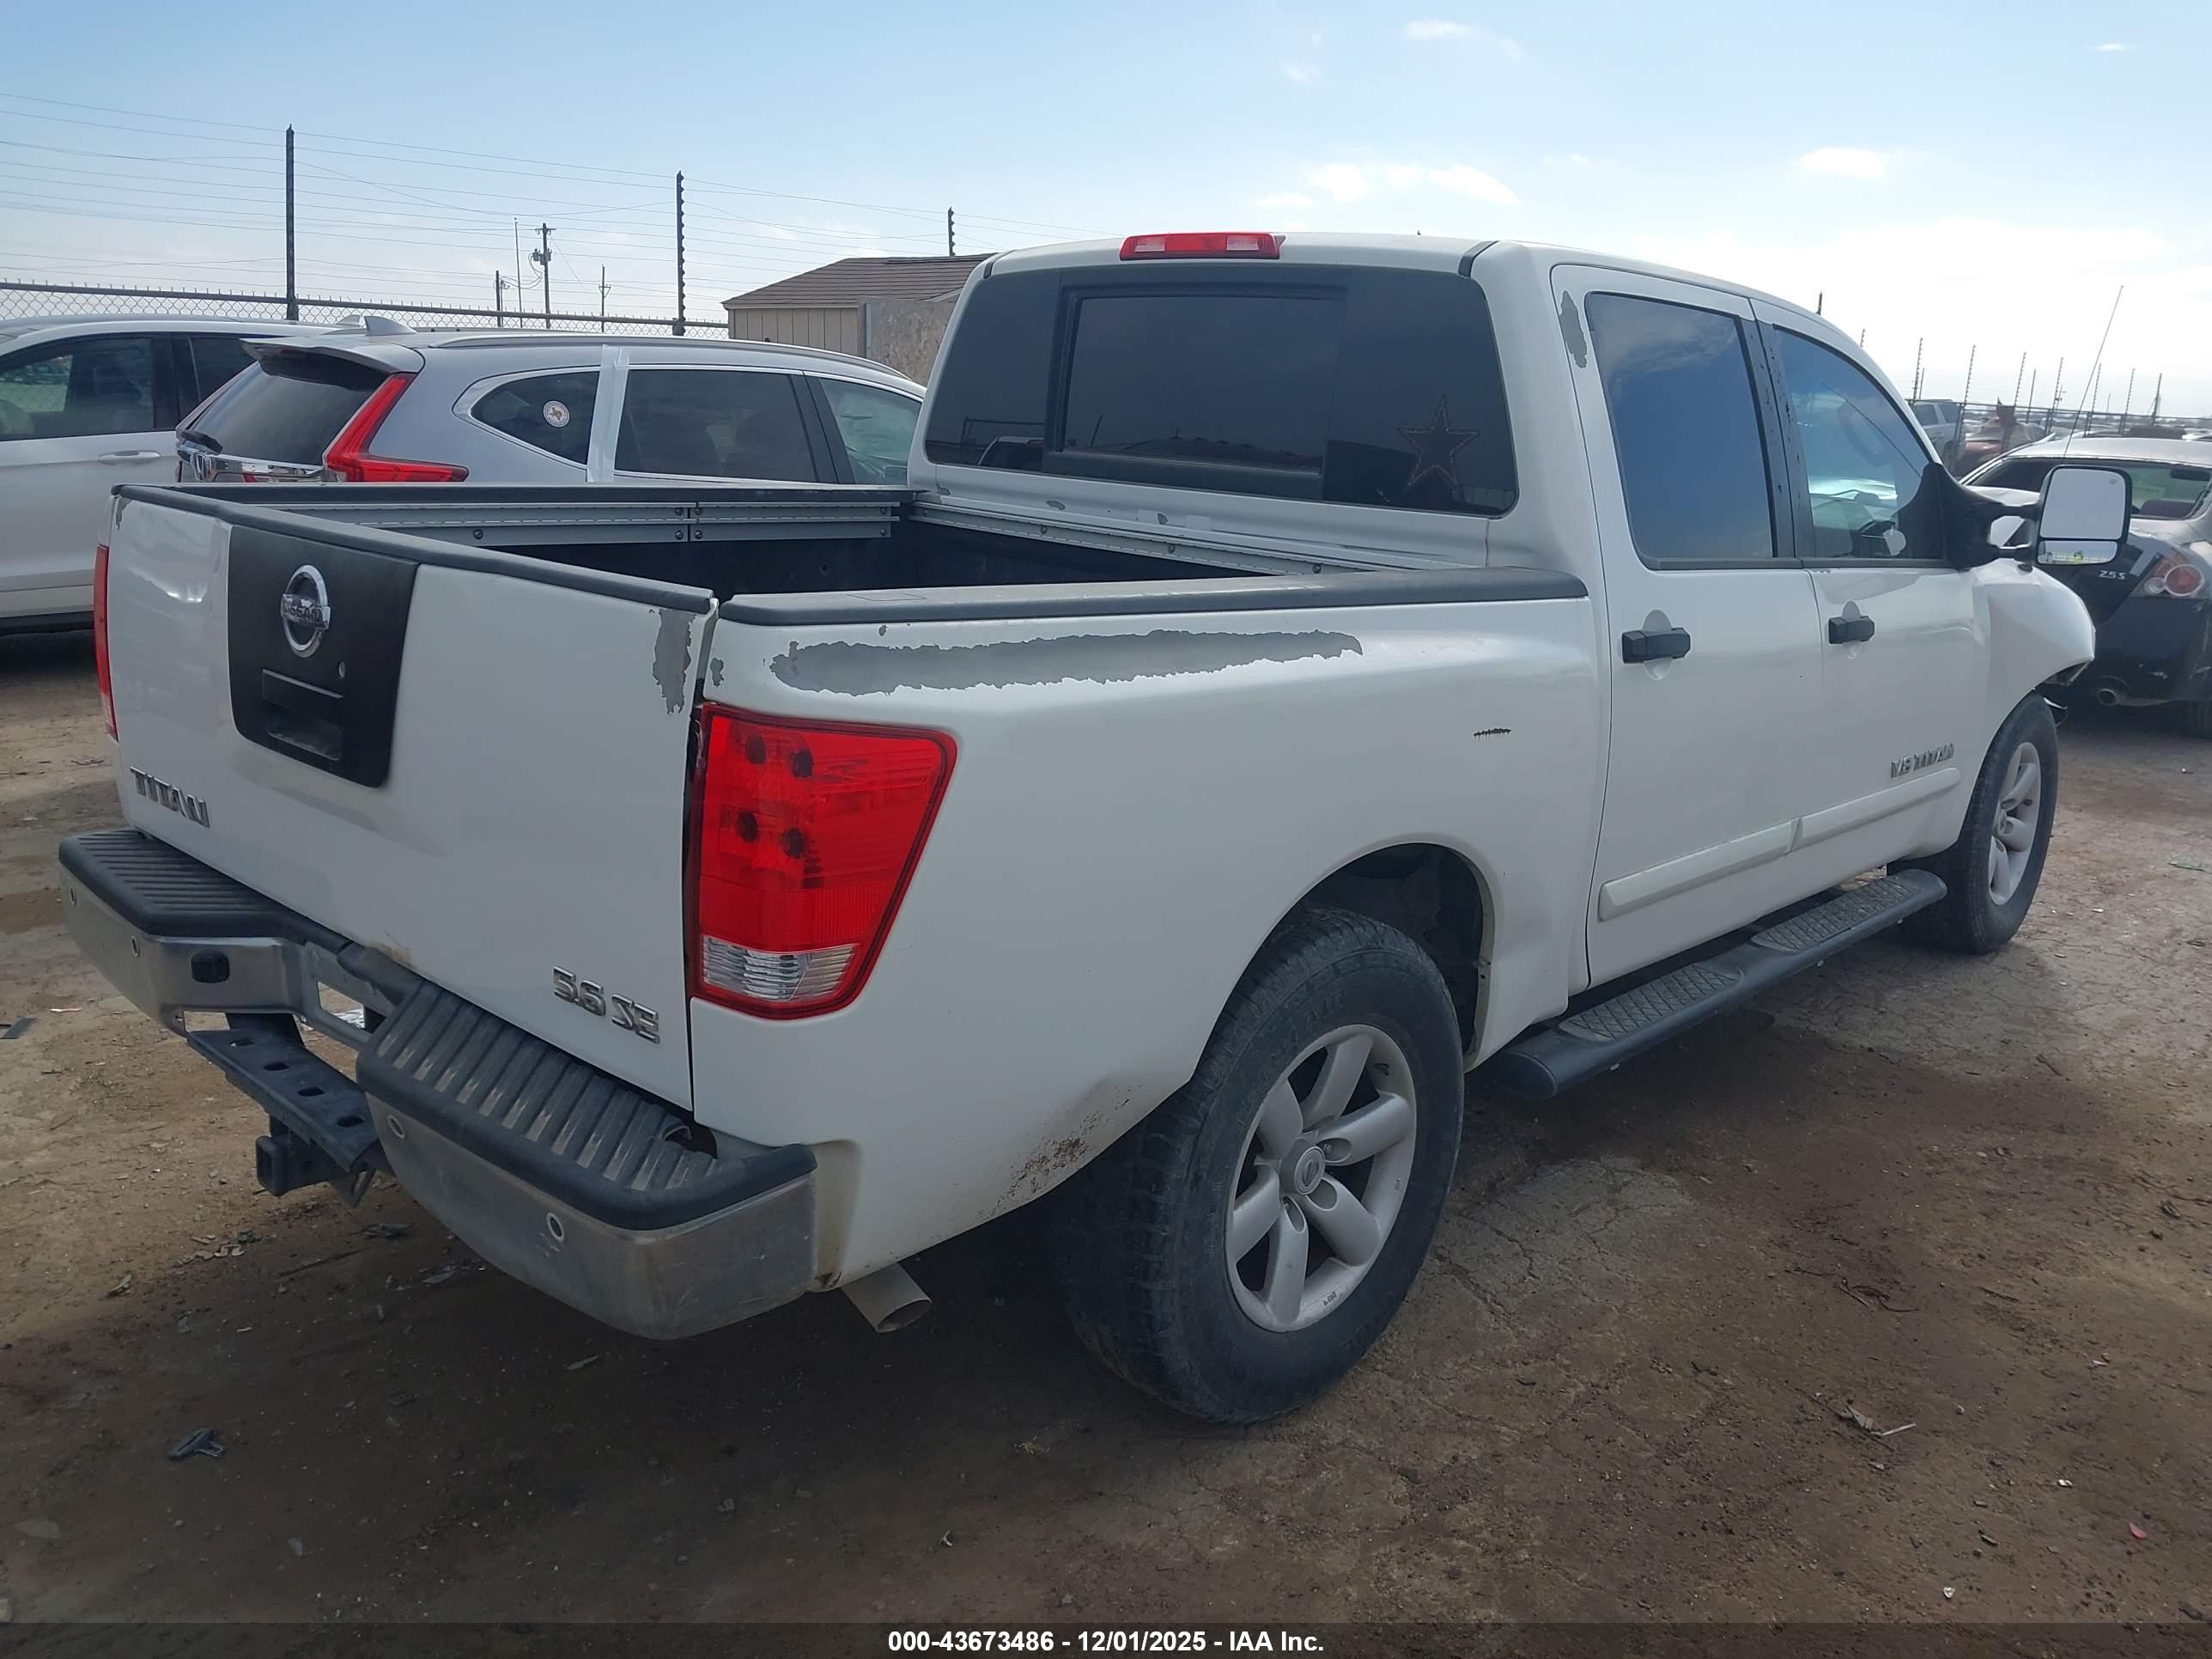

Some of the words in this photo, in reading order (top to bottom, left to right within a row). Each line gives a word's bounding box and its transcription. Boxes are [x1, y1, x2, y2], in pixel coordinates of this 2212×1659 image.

[130, 765, 210, 829] TITAN
[553, 965, 606, 1017] 5.6
[611, 993, 660, 1045] SE
